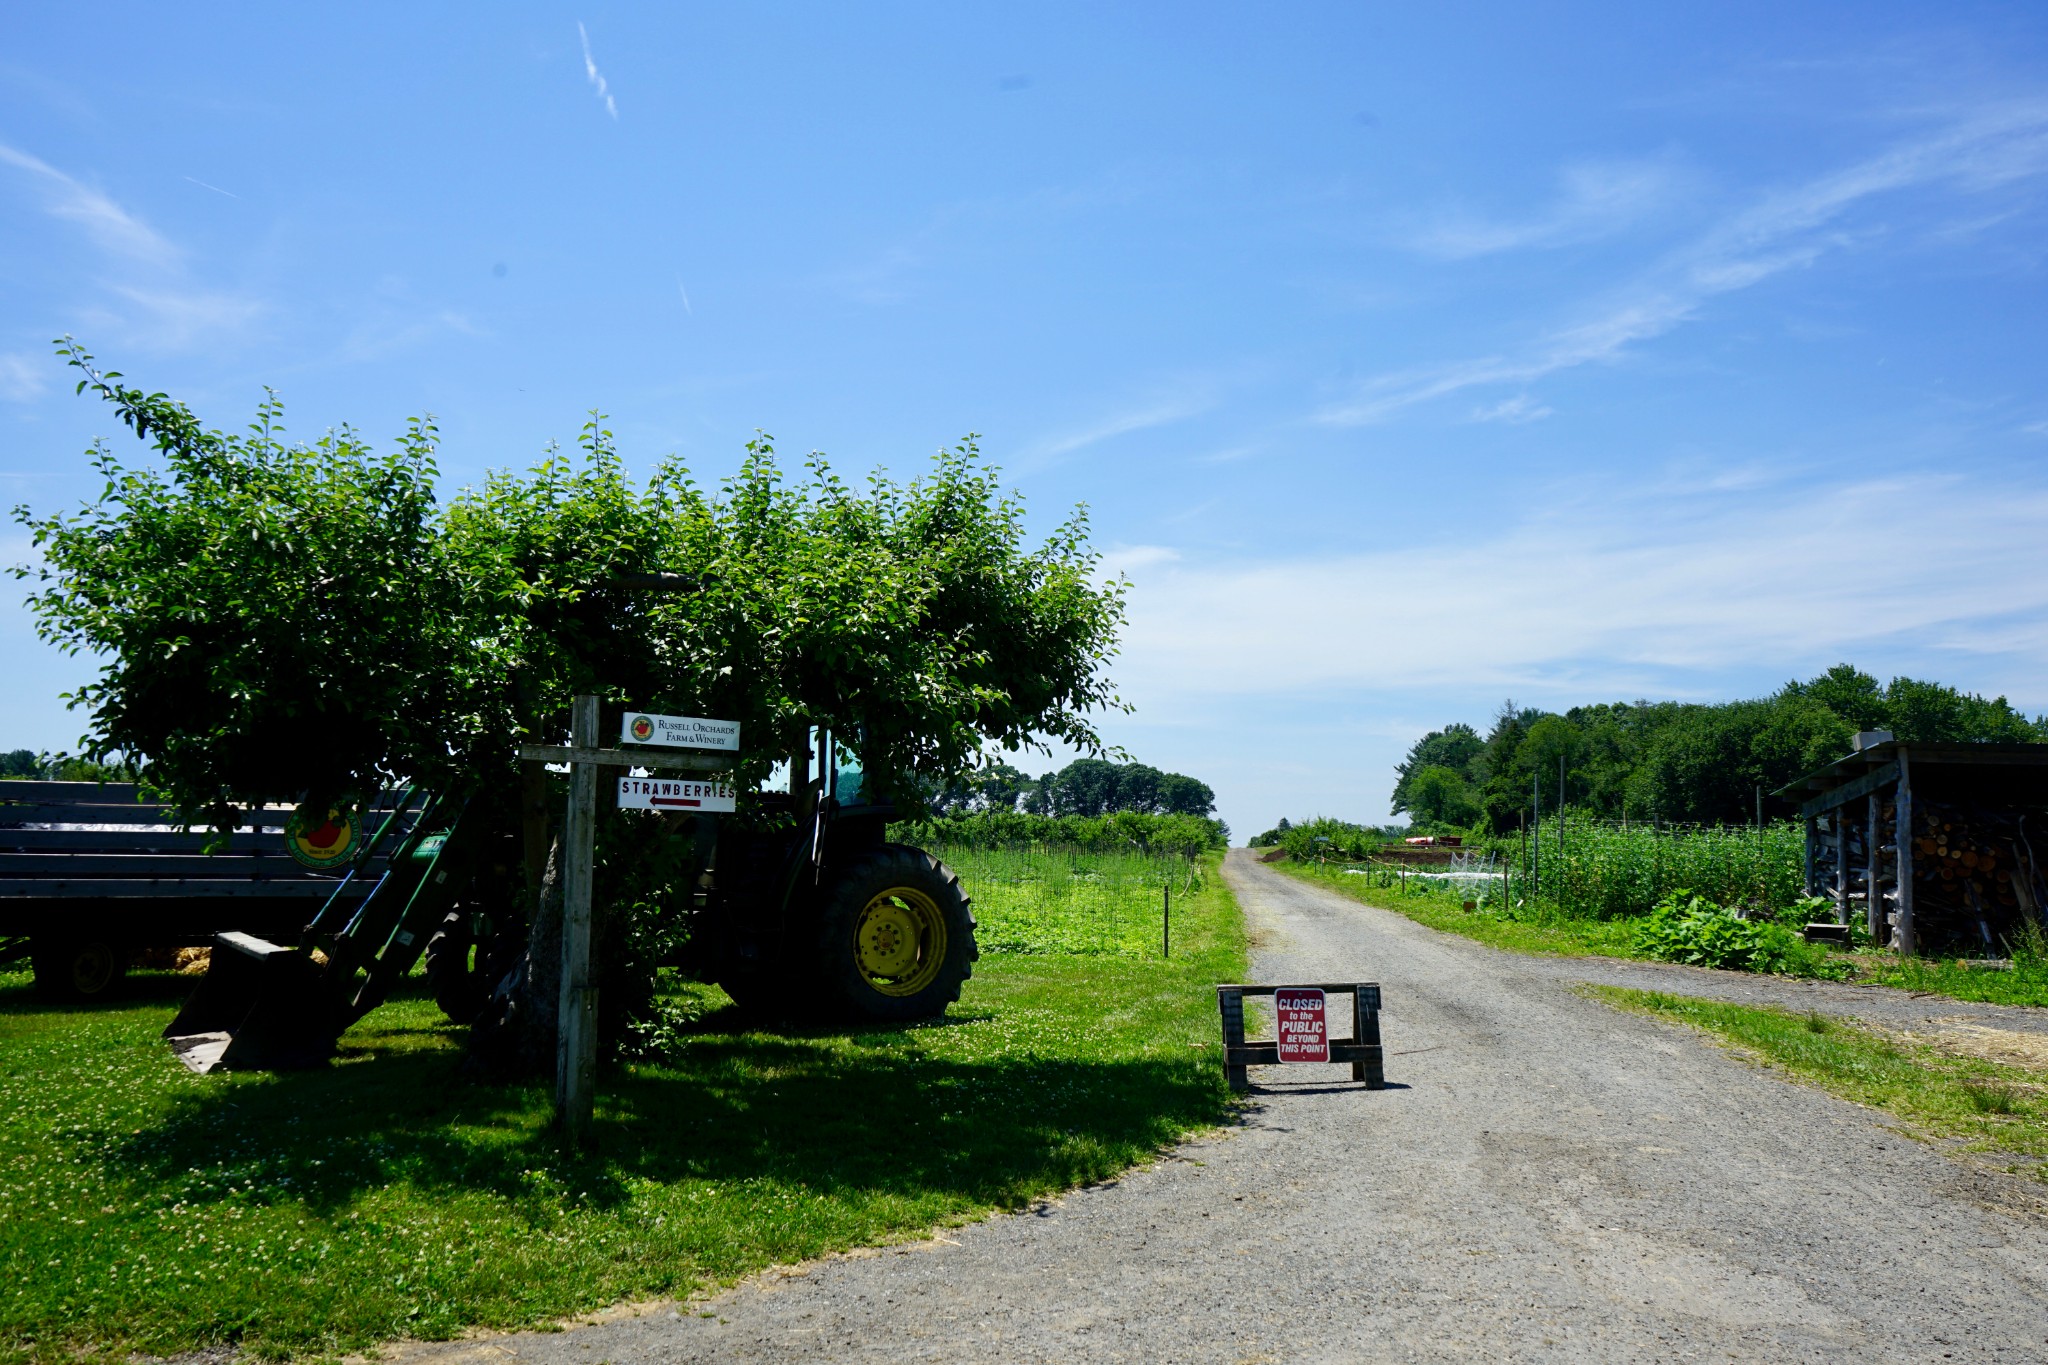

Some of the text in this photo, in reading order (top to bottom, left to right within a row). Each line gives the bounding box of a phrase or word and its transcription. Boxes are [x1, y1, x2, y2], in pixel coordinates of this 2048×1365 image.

[658, 720, 690, 731] RUSSELL
[692, 723, 735, 734] ORCHARDS
[666, 732, 688, 742] FARM
[695, 734, 726, 745] WINERY
[622, 782, 735, 798] STRAWBERRIES
[1279, 999, 1322, 1010] CLOSED
[1289, 1011, 1313, 1020] to the
[1281, 1021, 1323, 1033] PUBLIC
[1286, 1034, 1319, 1043] BEYOND
[1281, 1044, 1325, 1053] THIS POINT
